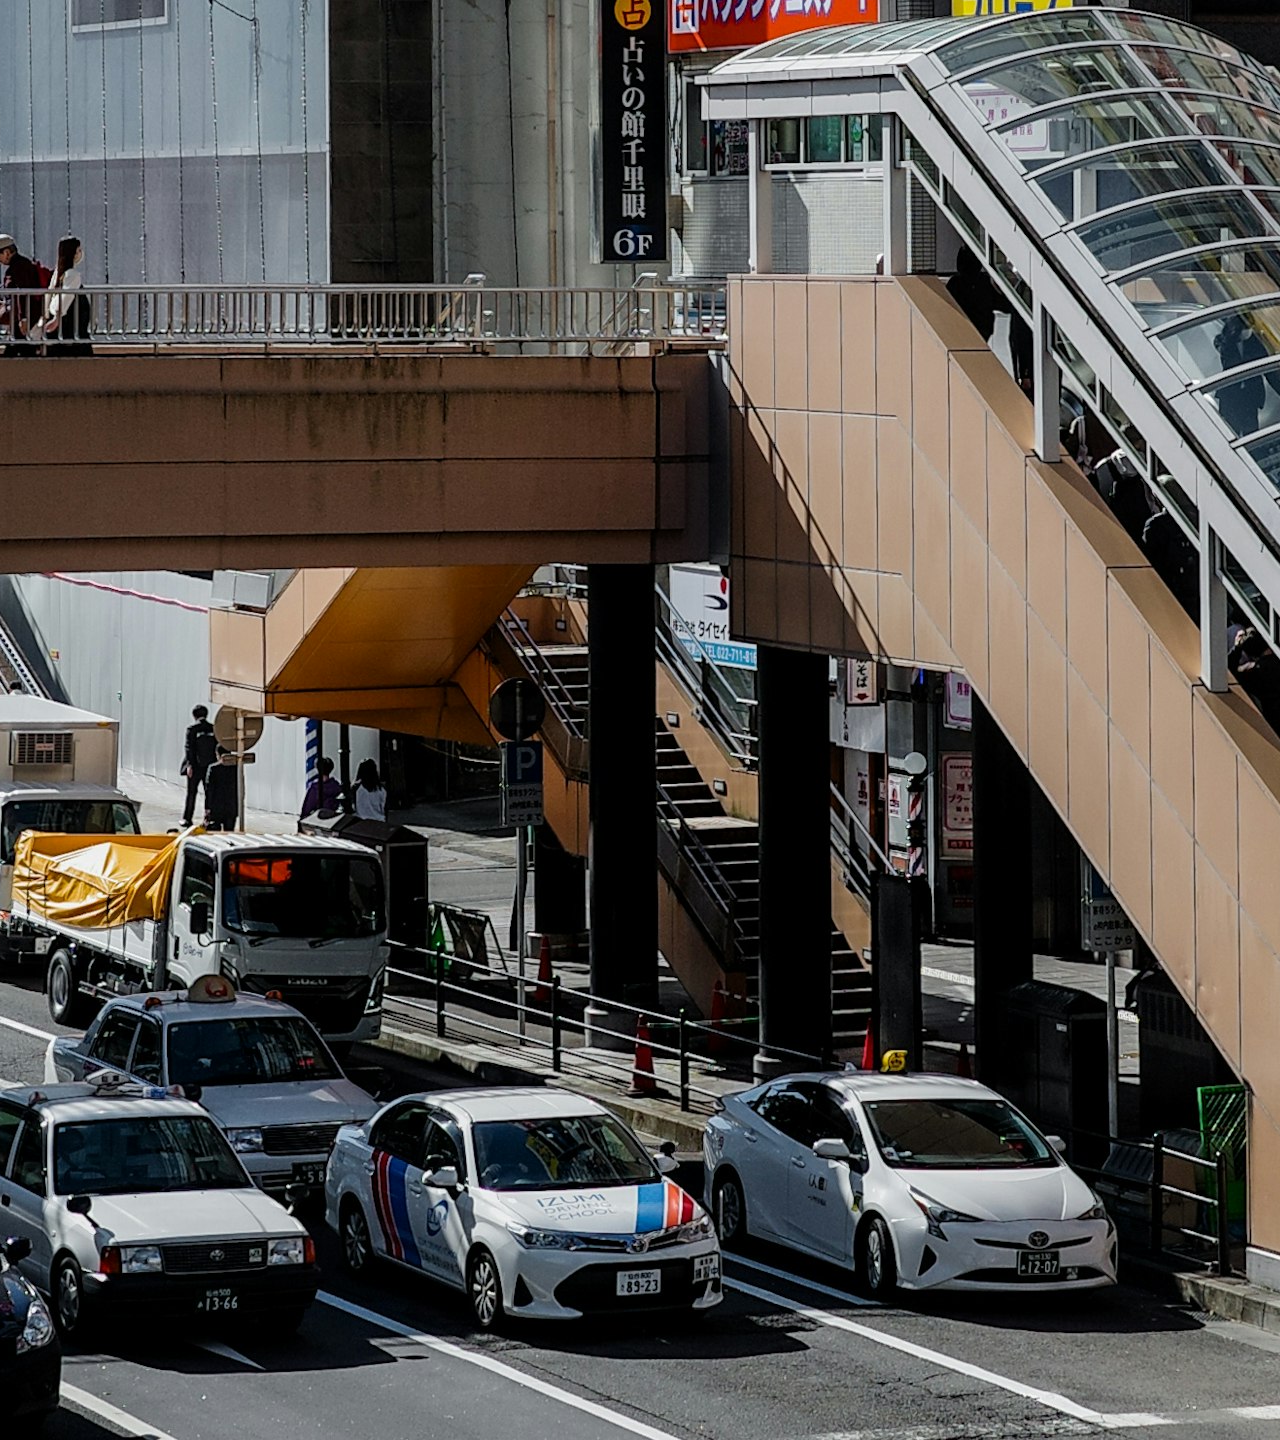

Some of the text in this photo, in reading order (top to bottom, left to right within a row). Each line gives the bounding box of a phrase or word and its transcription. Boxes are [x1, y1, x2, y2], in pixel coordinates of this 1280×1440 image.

[620, 37, 646, 220] 占いの館千里眼
[612, 230, 653, 257] 6F
[518, 746, 536, 779] P
[536, 1193, 606, 1208] IZUMI
[543, 1201, 612, 1215] DRIVING
[549, 1208, 617, 1221] SCHOOL
[1026, 1261, 1058, 1274] 12-07
[625, 1279, 659, 1294] 89-23
[206, 1296, 238, 1311] 13-66
